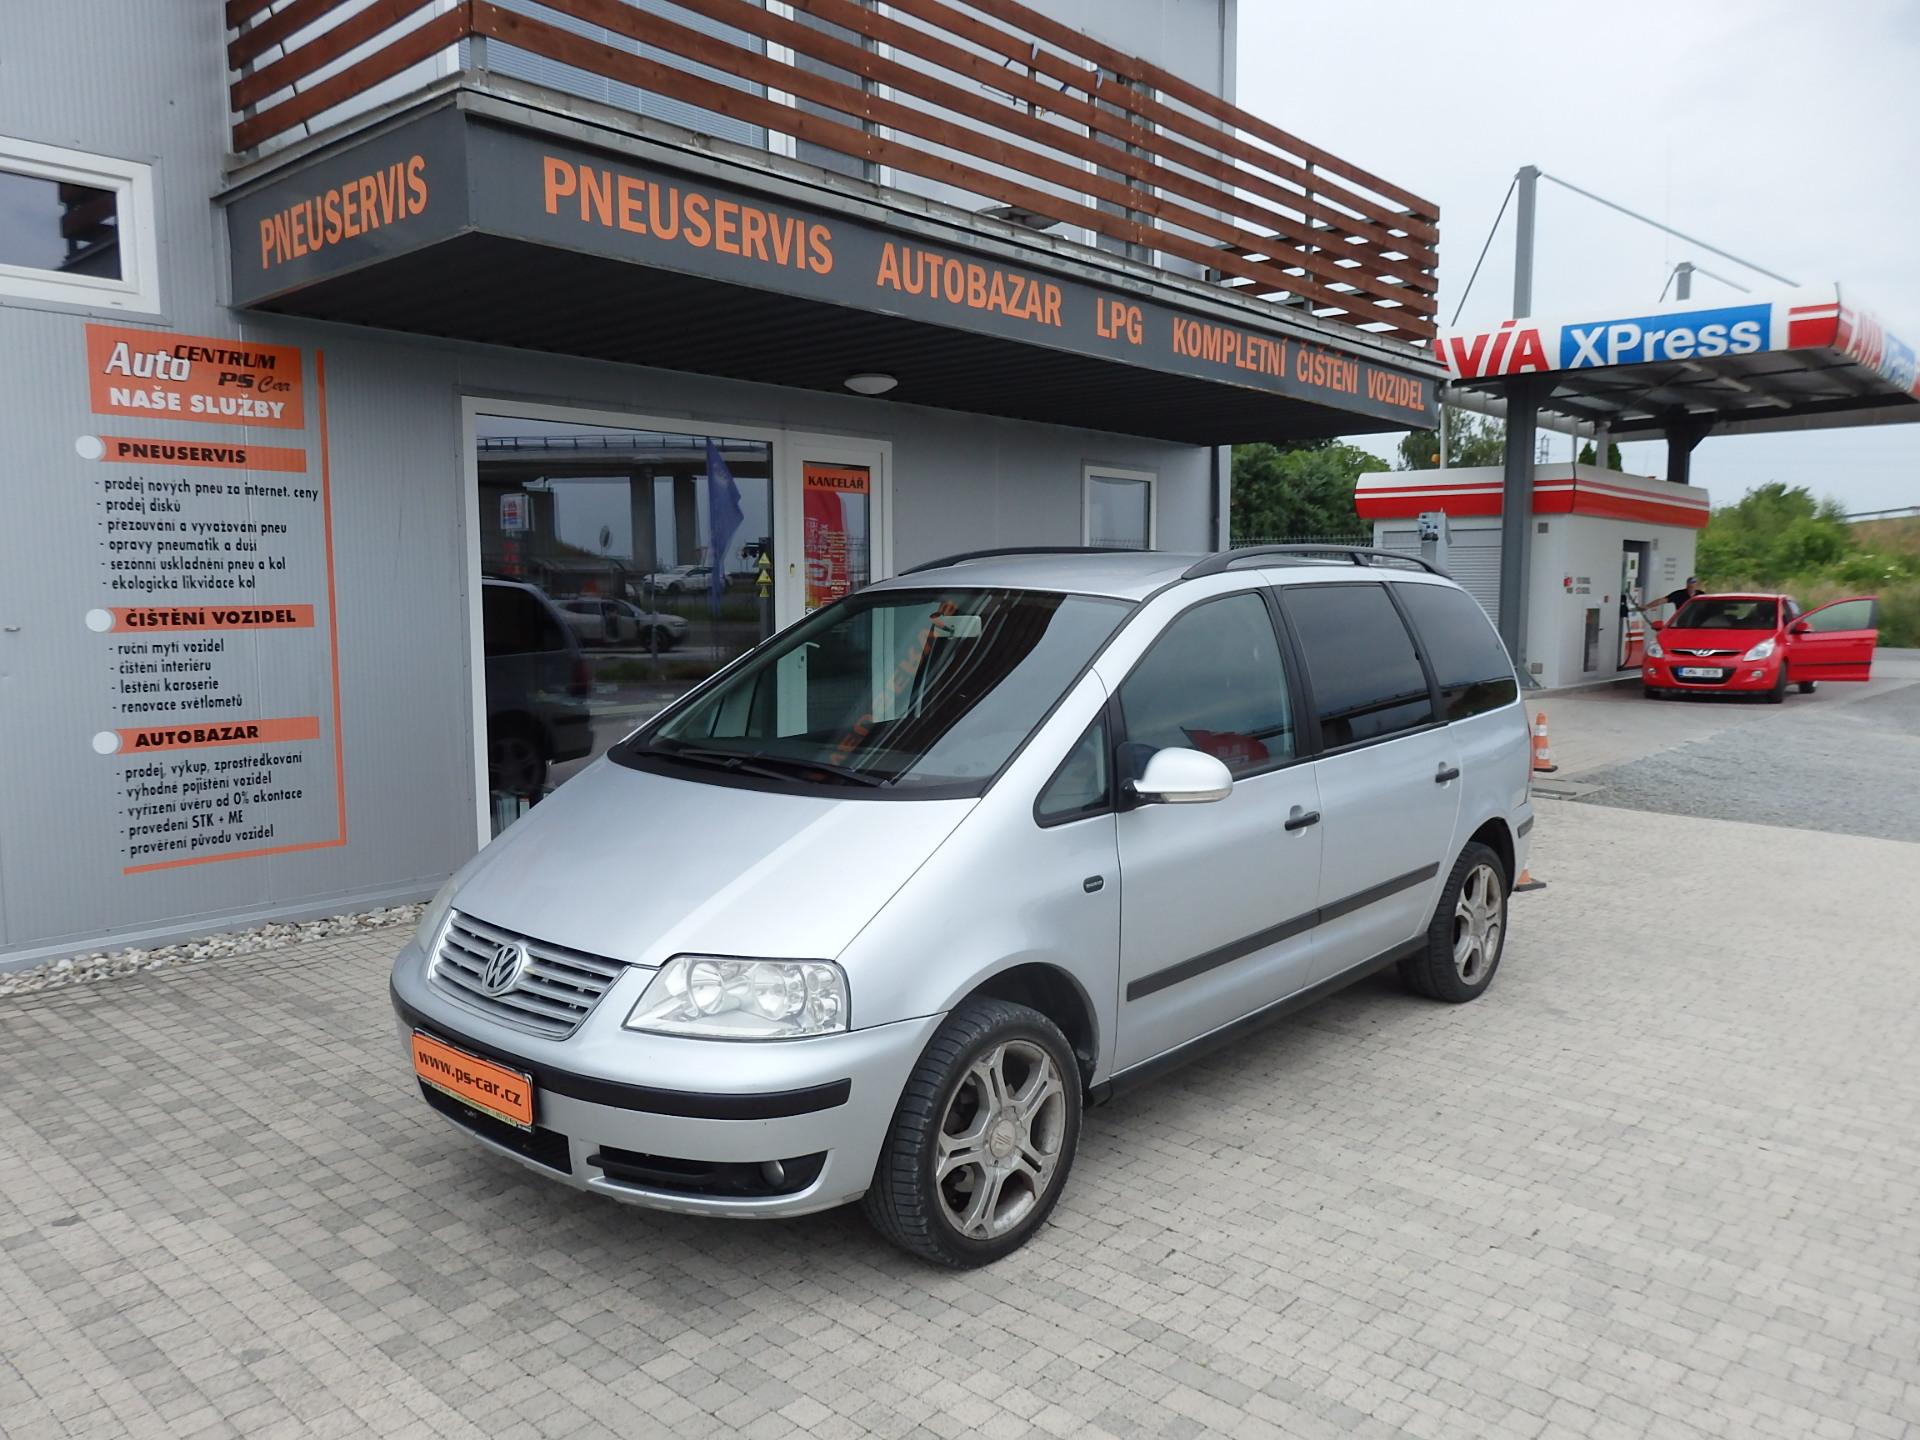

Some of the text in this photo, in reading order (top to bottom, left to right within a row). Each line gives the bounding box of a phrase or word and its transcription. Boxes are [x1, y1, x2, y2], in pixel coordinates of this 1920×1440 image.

[260, 155, 427, 270] PNEUSERVIS
[543, 156, 1425, 411] PNEUSERVIS AUTOBAZAR LPG KOMPLETNÍ ČIŠTĚNÍ VOZIDEL
[1568, 320, 1761, 369] XPress
[104, 341, 276, 381] Auto CENTRUM
[218, 372, 292, 393] PS Car
[110, 385, 285, 419] NAŠE SLUŽBY
[118, 442, 247, 464] PNEUSERVIS
[105, 476, 318, 502] prodej nových pneu za internet. ceny
[808, 475, 864, 489] KANCELÁŘ
[106, 497, 145, 515] prodej
[180, 522, 187, 531] a
[261, 524, 287, 537] pneu
[109, 541, 152, 554] opravy
[157, 537, 220, 554] pneumatik
[224, 542, 231, 551] a
[228, 561, 255, 573] pneu
[258, 561, 265, 570] a
[268, 556, 286, 570] kol
[182, 575, 234, 589] likvidace
[238, 575, 256, 589] kol
[125, 608, 296, 626] ČIŠTĚNÍ VOZIDEL
[183, 638, 224, 653] vozidel
[164, 676, 219, 692] karoserie
[122, 700, 176, 713] renovace
[135, 726, 259, 748] AUTOBAZAR
[233, 771, 272, 787] vozidel
[216, 793, 229, 807] od
[234, 790, 249, 805] 0%
[253, 789, 303, 803] akontace
[192, 813, 214, 829] STK
[228, 810, 243, 824] ME
[235, 824, 274, 841] vozidel
[418, 1050, 522, 1108] www.ps-car.cz
